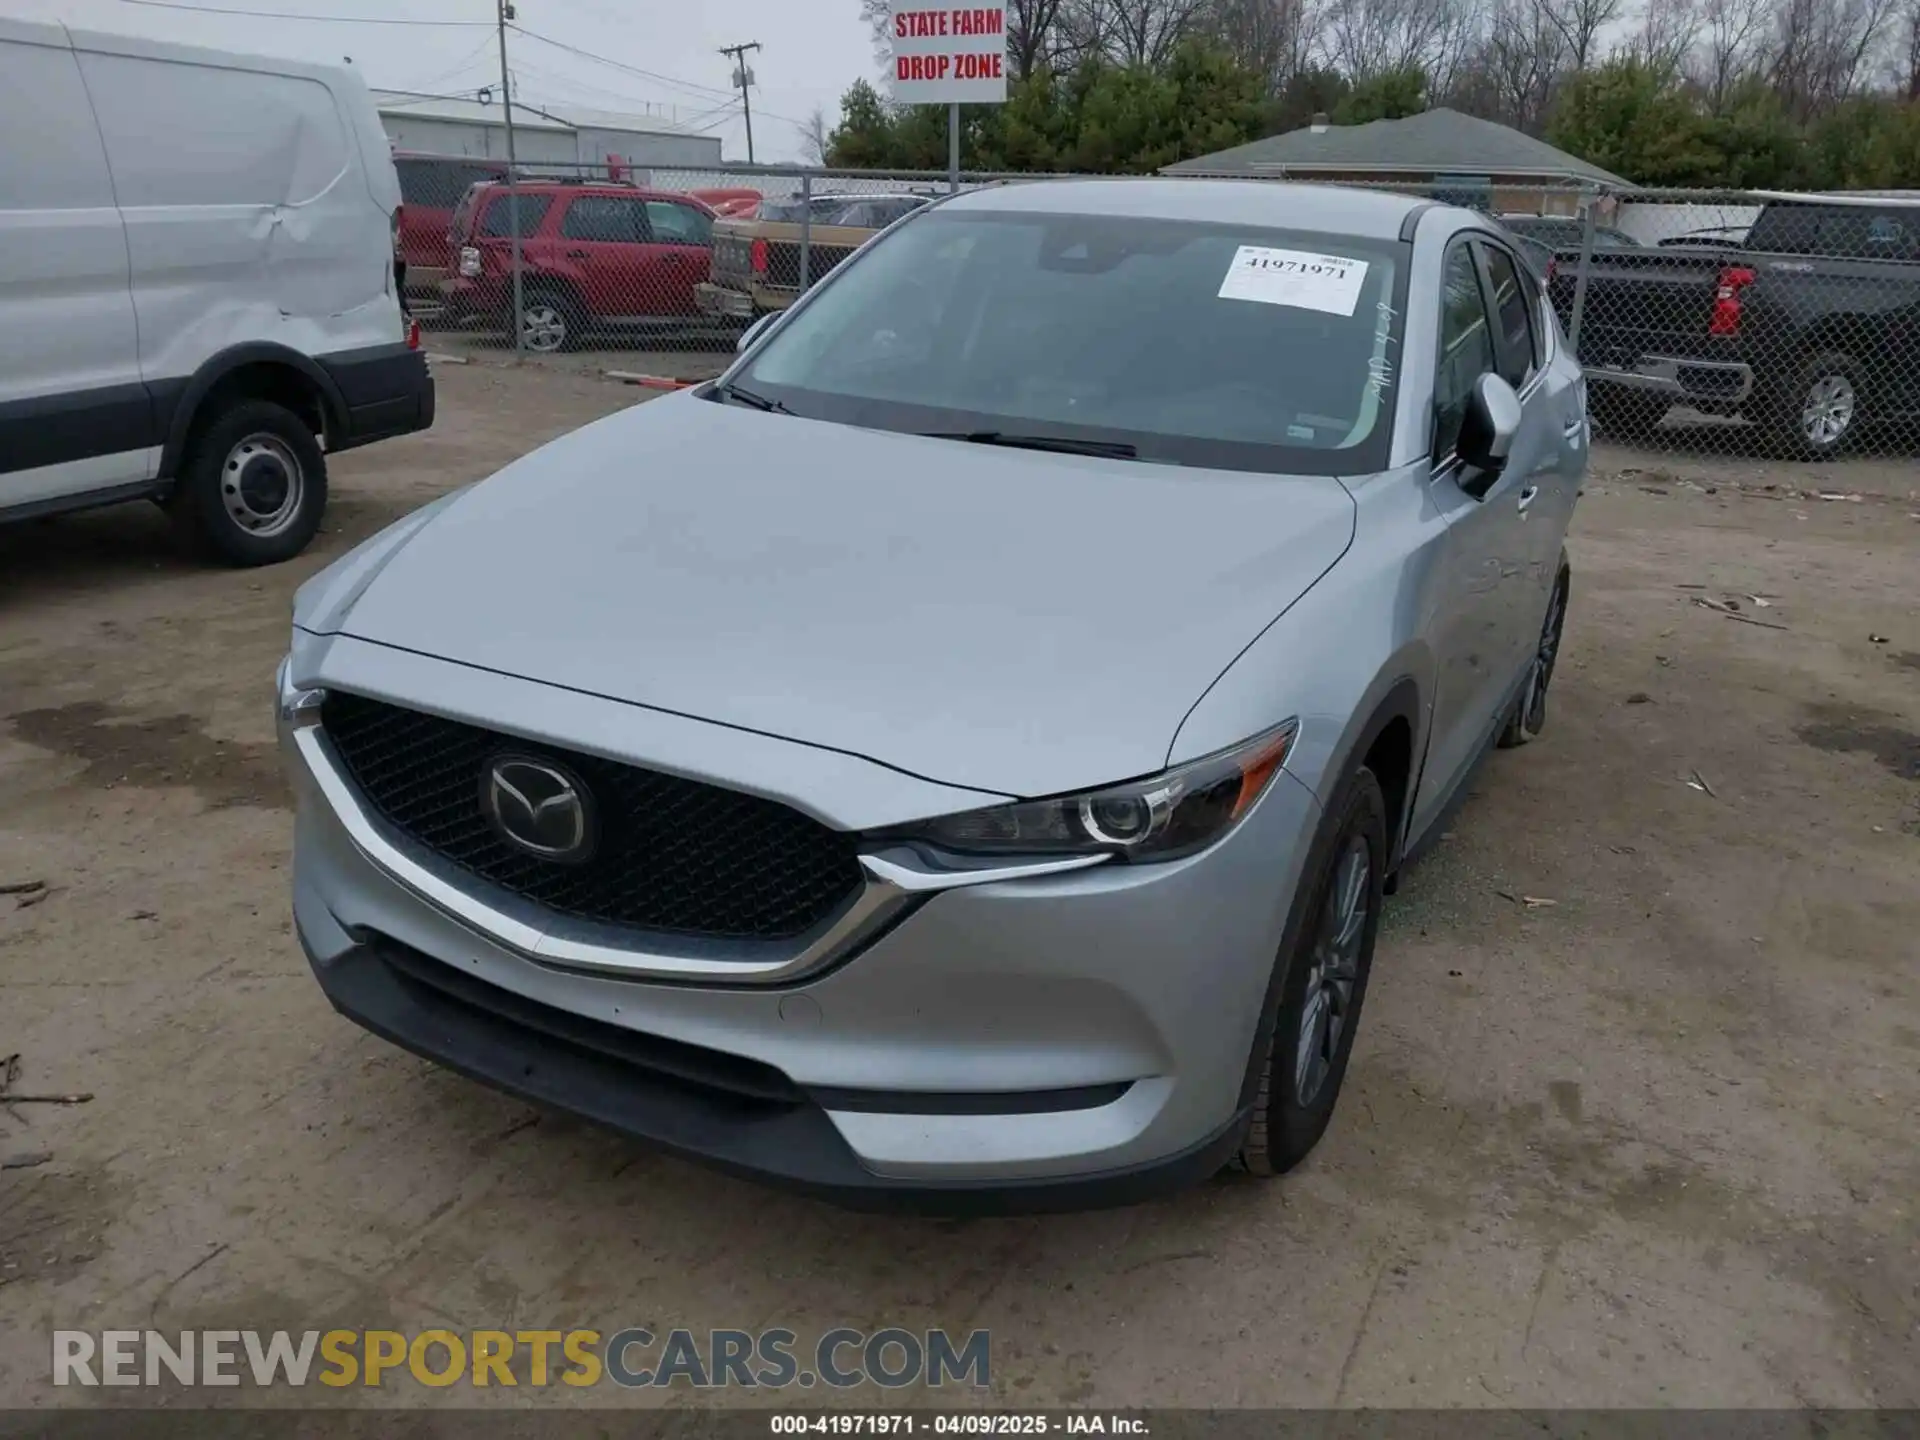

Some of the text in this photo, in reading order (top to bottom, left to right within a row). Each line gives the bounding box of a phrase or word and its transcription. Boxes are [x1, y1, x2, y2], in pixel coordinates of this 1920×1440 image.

[896, 8, 1003, 37] STATE FARM
[897, 53, 1003, 80] DROP ZONE
[1245, 257, 1347, 279] 41971971
